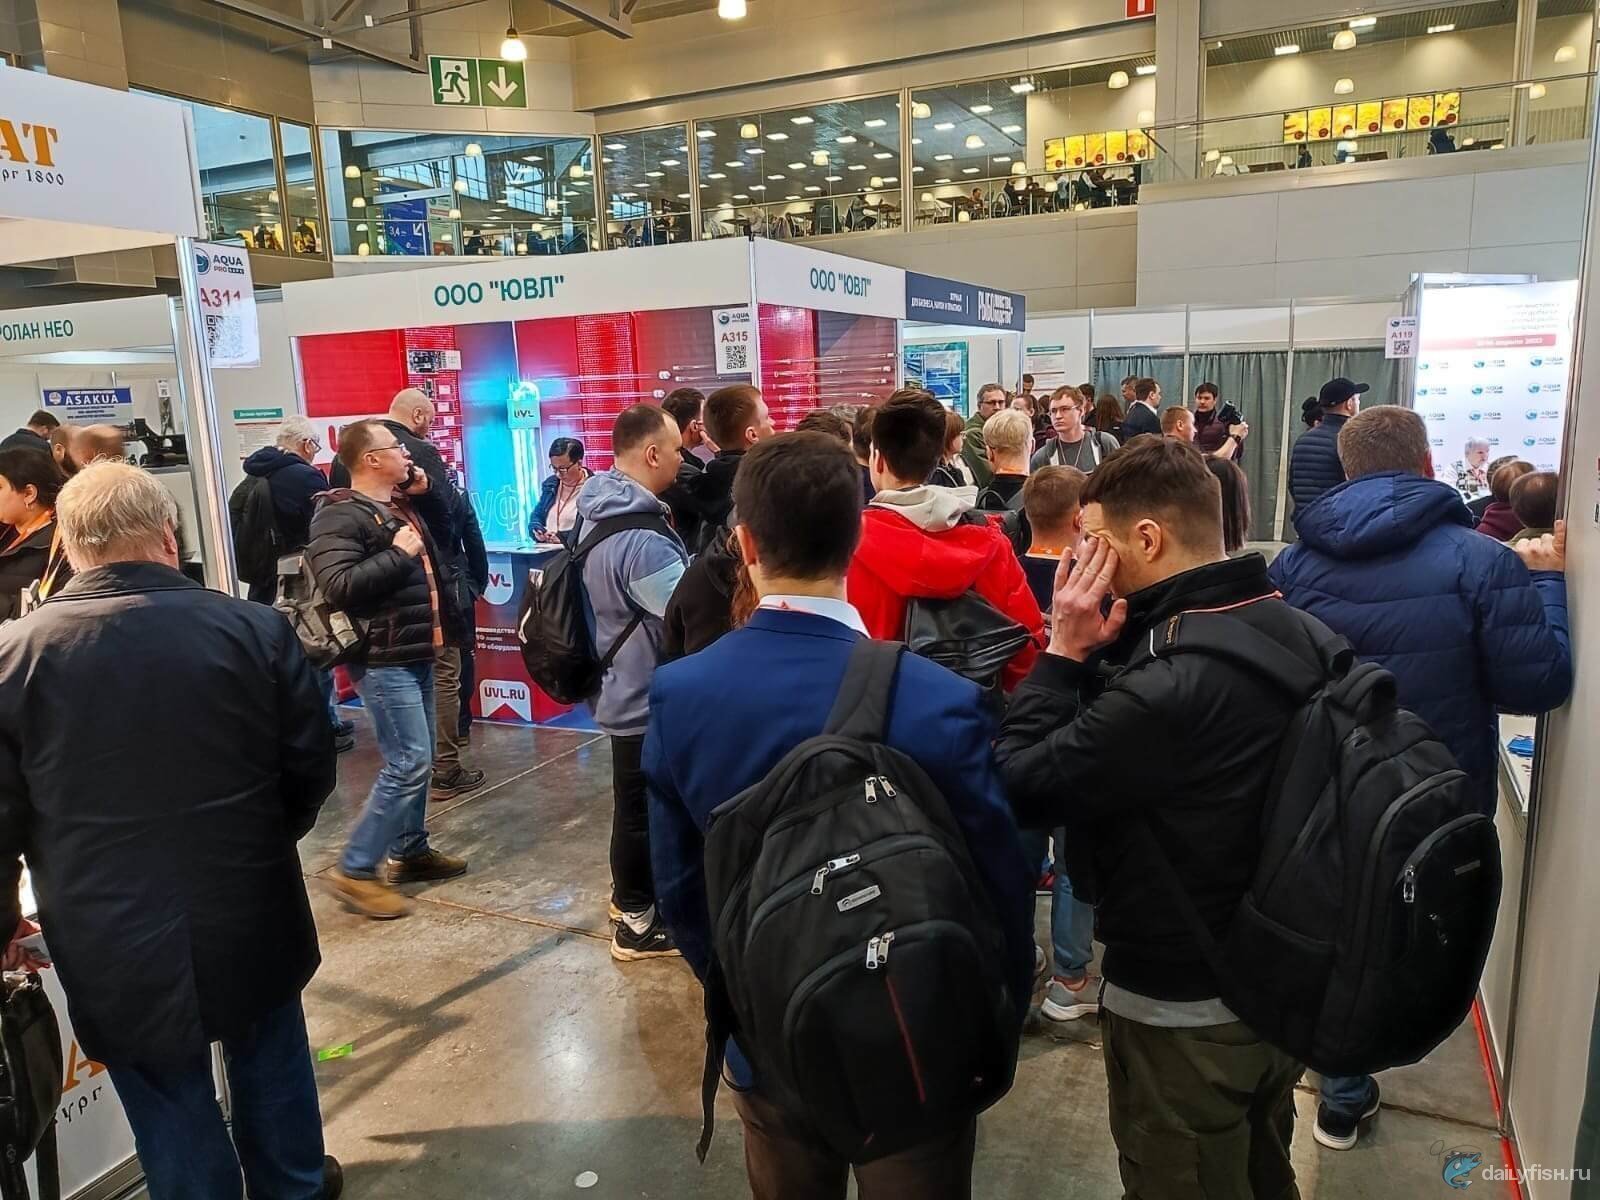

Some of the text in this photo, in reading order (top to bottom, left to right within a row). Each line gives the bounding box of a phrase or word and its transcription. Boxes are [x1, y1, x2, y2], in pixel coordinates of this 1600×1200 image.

[26, 169, 64, 186] 1800
[213, 254, 243, 266] AQUA
[810, 268, 871, 297] ООО "ЮВЛ"
[434, 275, 564, 306] ООО "ЮВЛ"
[44, 319, 74, 338] НЕО
[721, 331, 748, 343] A315
[65, 394, 119, 406] ASAKUA
[513, 409, 534, 418] UVL
[488, 574, 512, 588] VL
[484, 686, 525, 700] UVL.RU
